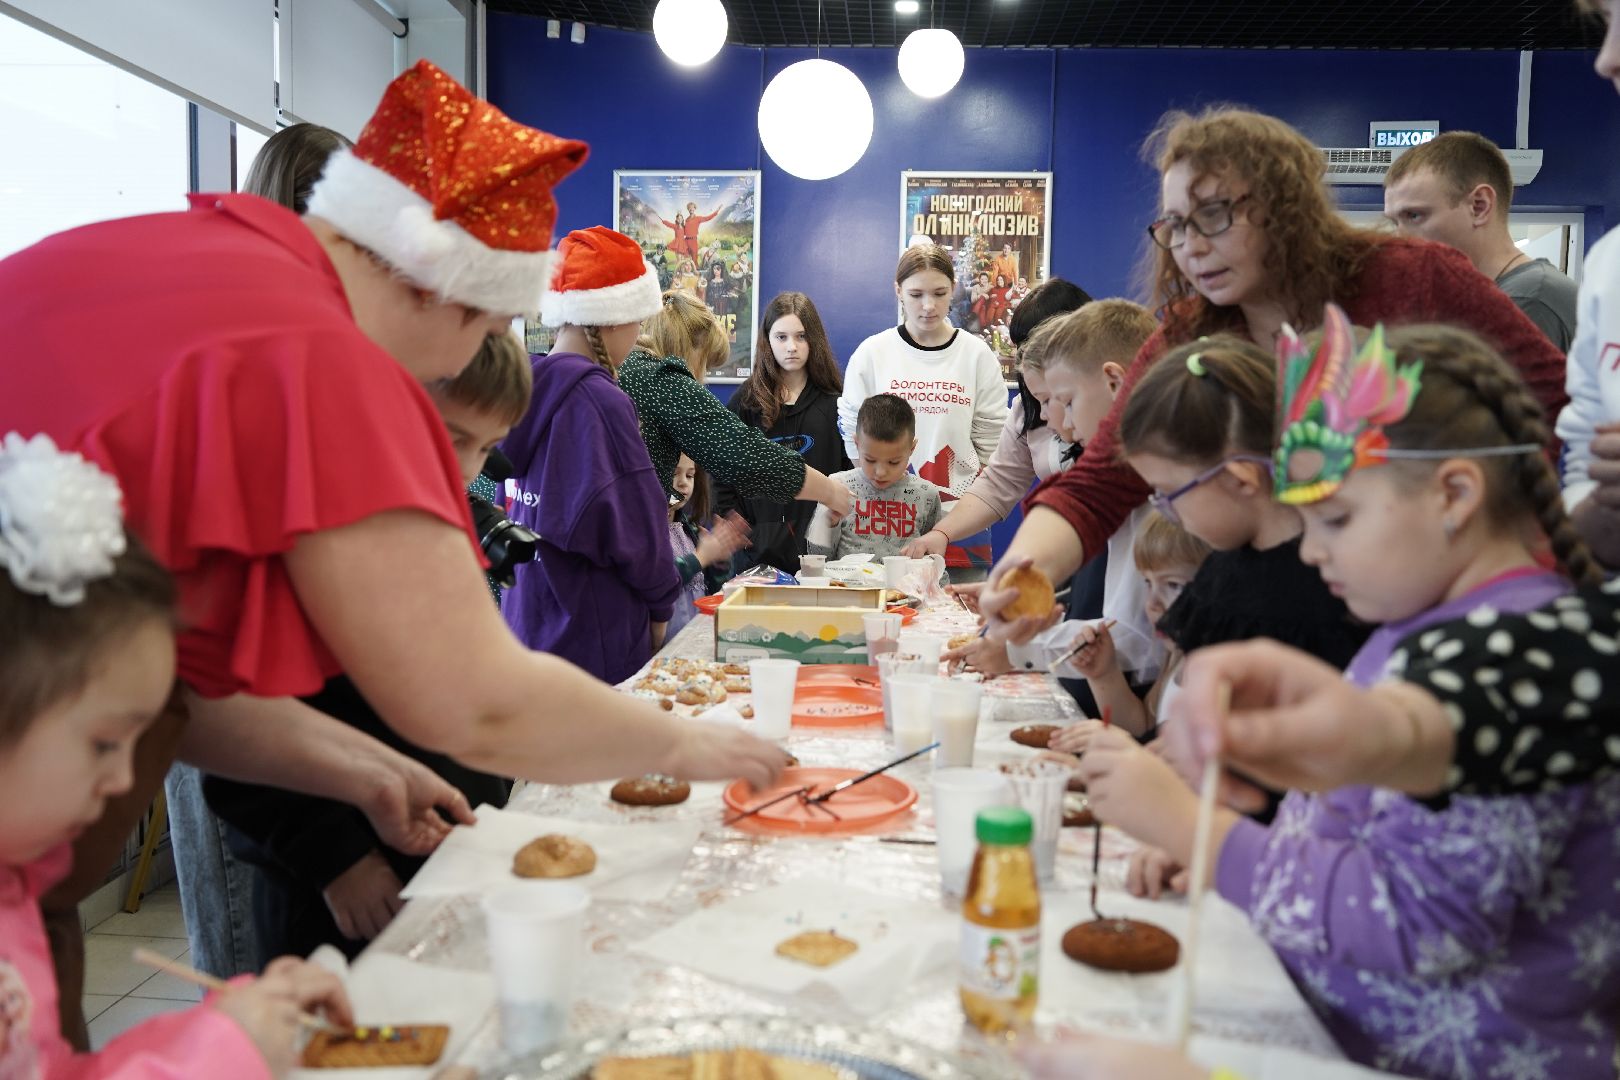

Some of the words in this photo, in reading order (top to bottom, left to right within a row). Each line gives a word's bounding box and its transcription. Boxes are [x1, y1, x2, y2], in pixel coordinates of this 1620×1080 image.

[1377, 131, 1434, 146] ВЫХОД
[930, 192, 1023, 213] НОВОГОДНИЙ
[913, 213, 937, 235] ОЛ
[890, 379, 965, 393] ВОЛОНТЕРЫ
[882, 391, 971, 407] ДМОСКОВЬЯ
[919, 406, 949, 415] РЯДОМ
